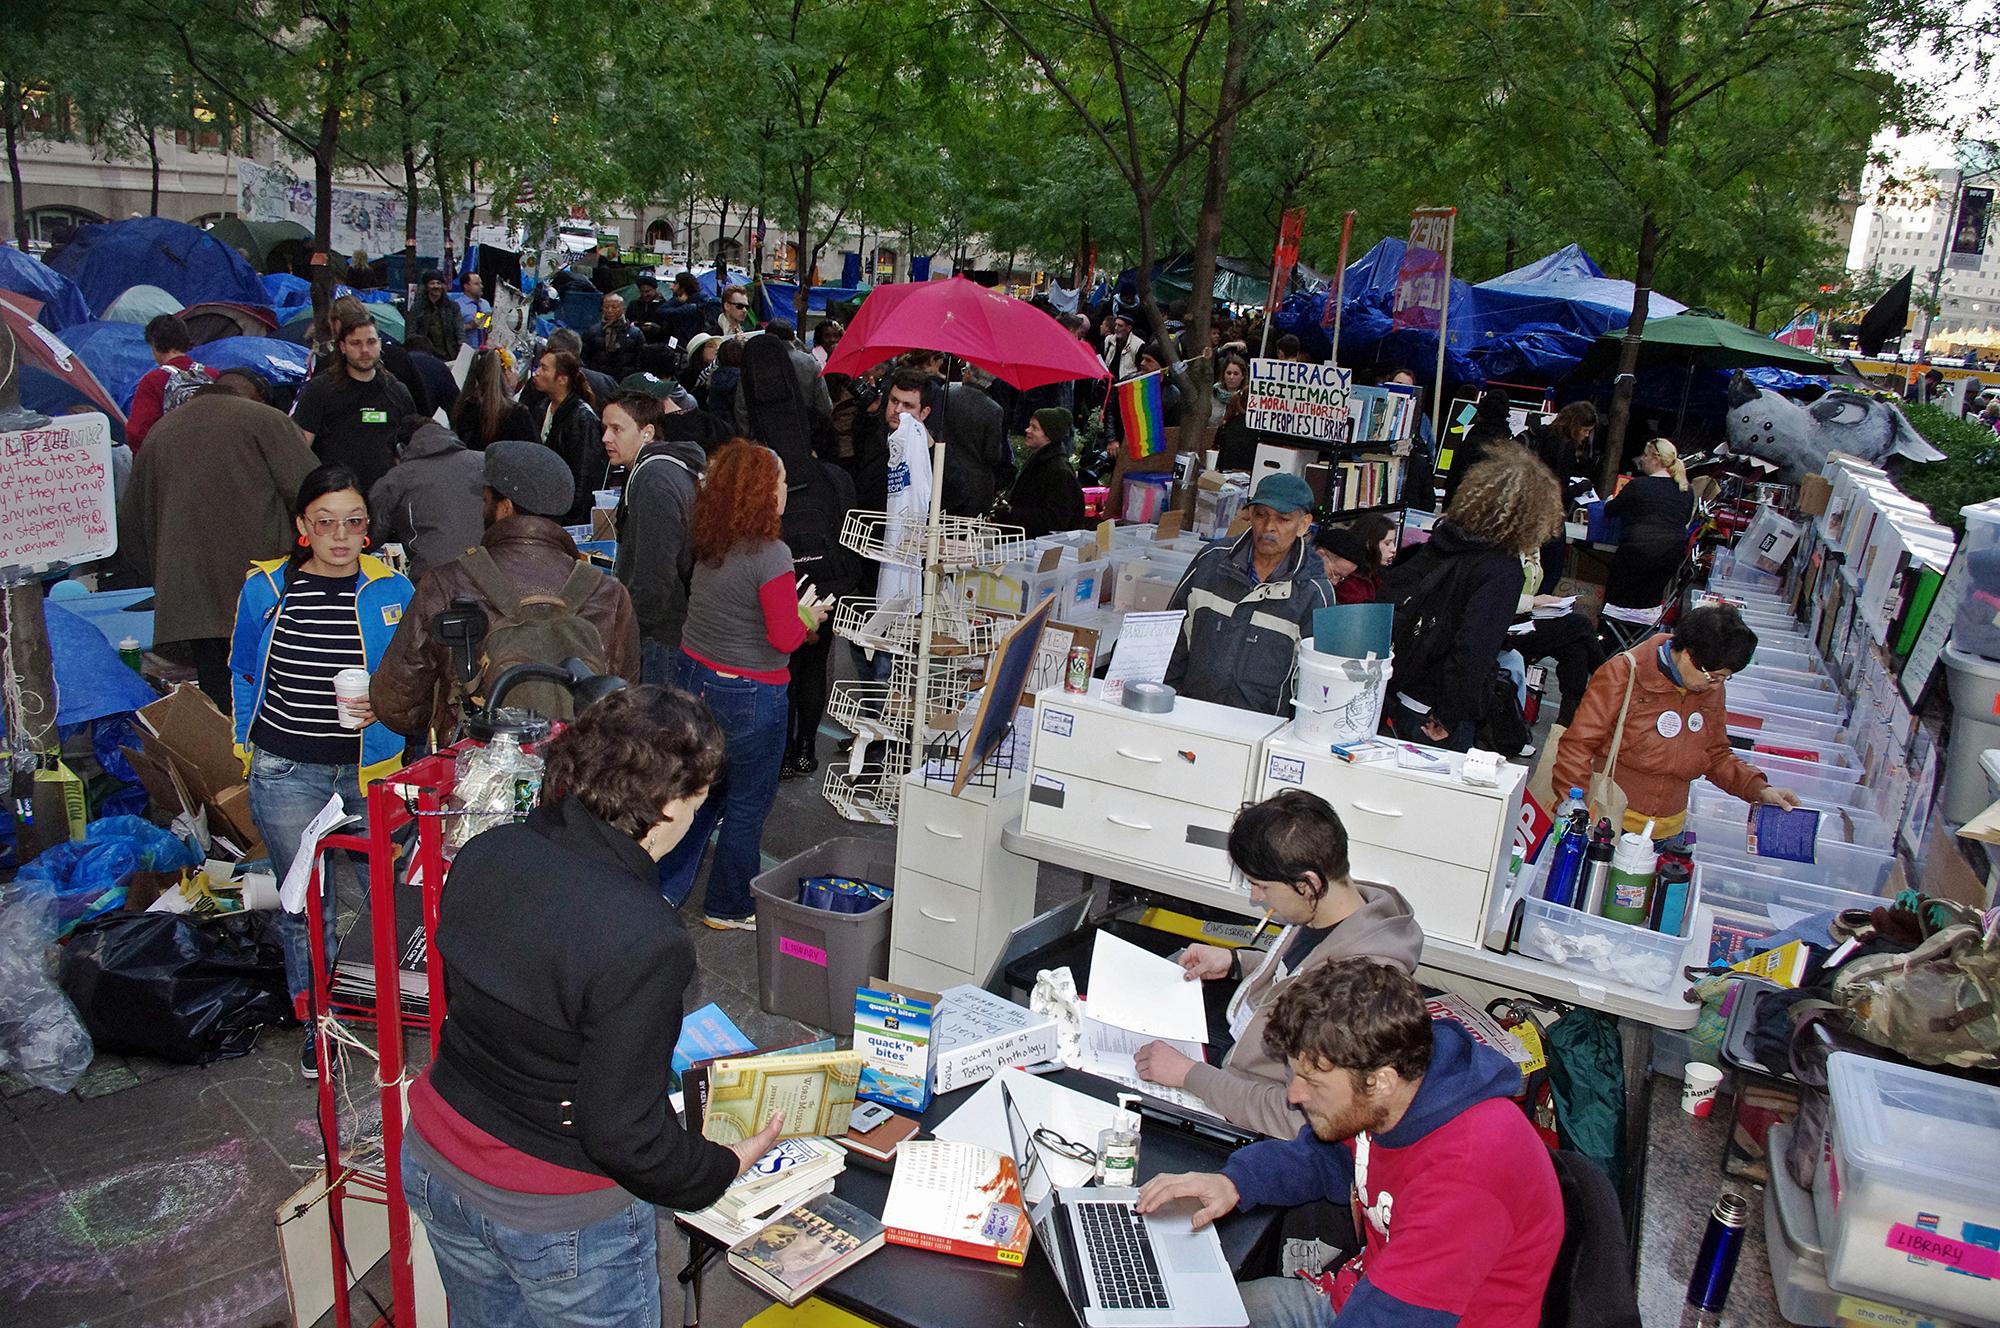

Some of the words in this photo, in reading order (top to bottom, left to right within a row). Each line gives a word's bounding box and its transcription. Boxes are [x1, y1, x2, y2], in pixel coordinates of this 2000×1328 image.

[1248, 396, 1258, 409] &
[1260, 397, 1290, 412] MORAL
[1247, 409, 1269, 429] THE
[14, 456, 49, 471] took
[50, 453, 77, 465] the
[77, 449, 90, 461] 3
[1, 476, 14, 490] of
[18, 475, 41, 487] the
[45, 467, 73, 481] OWS
[29, 487, 55, 502] they
[59, 480, 89, 494] turn
[91, 479, 106, 492] up
[2, 501, 72, 524] anywhere
[1070, 656, 1086, 673] V8
[868, 1002, 897, 1015] quack'n
[897, 1009, 918, 1018] bites
[867, 1036, 913, 1053] quack'n
[876, 1047, 905, 1062] bites
[996, 1038, 1014, 1052] Wall
[962, 1063, 995, 1080] Poetry
[997, 1041, 1047, 1067] Anthology
[1524, 1058, 1541, 1069] 2011
[1897, 1231, 1964, 1266] LIBRARY
[1856, 1307, 1876, 1320] the
[1877, 1311, 1909, 1327] office
